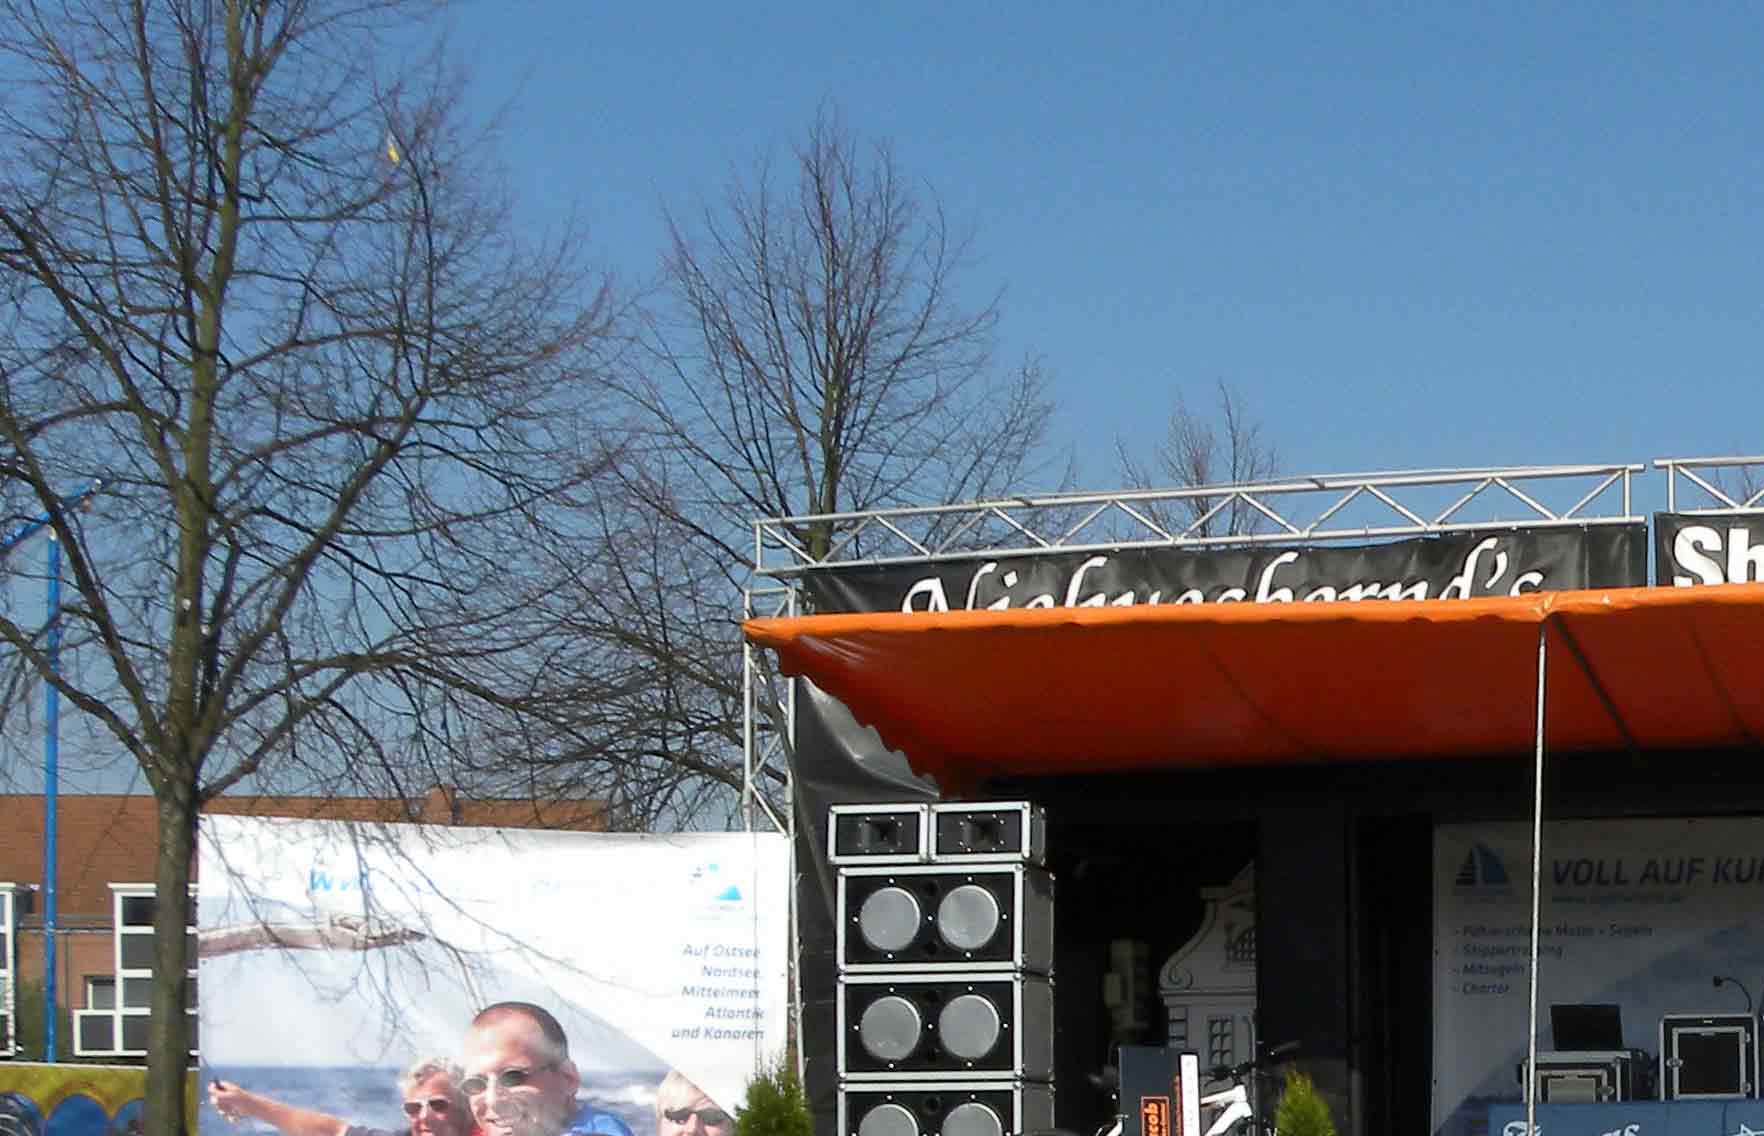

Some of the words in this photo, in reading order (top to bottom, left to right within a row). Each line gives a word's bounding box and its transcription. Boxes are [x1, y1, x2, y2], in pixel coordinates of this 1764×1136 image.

[1551, 857, 1629, 886] VOLL
[1638, 857, 1705, 885] AUF
[682, 943, 709, 959] Auf
[702, 964, 761, 979] Nordsee
[681, 985, 761, 1000] Mittelmeer
[704, 1005, 766, 1020] Atlantik
[671, 1025, 701, 1040] und
[703, 1026, 766, 1041] Kanaren
